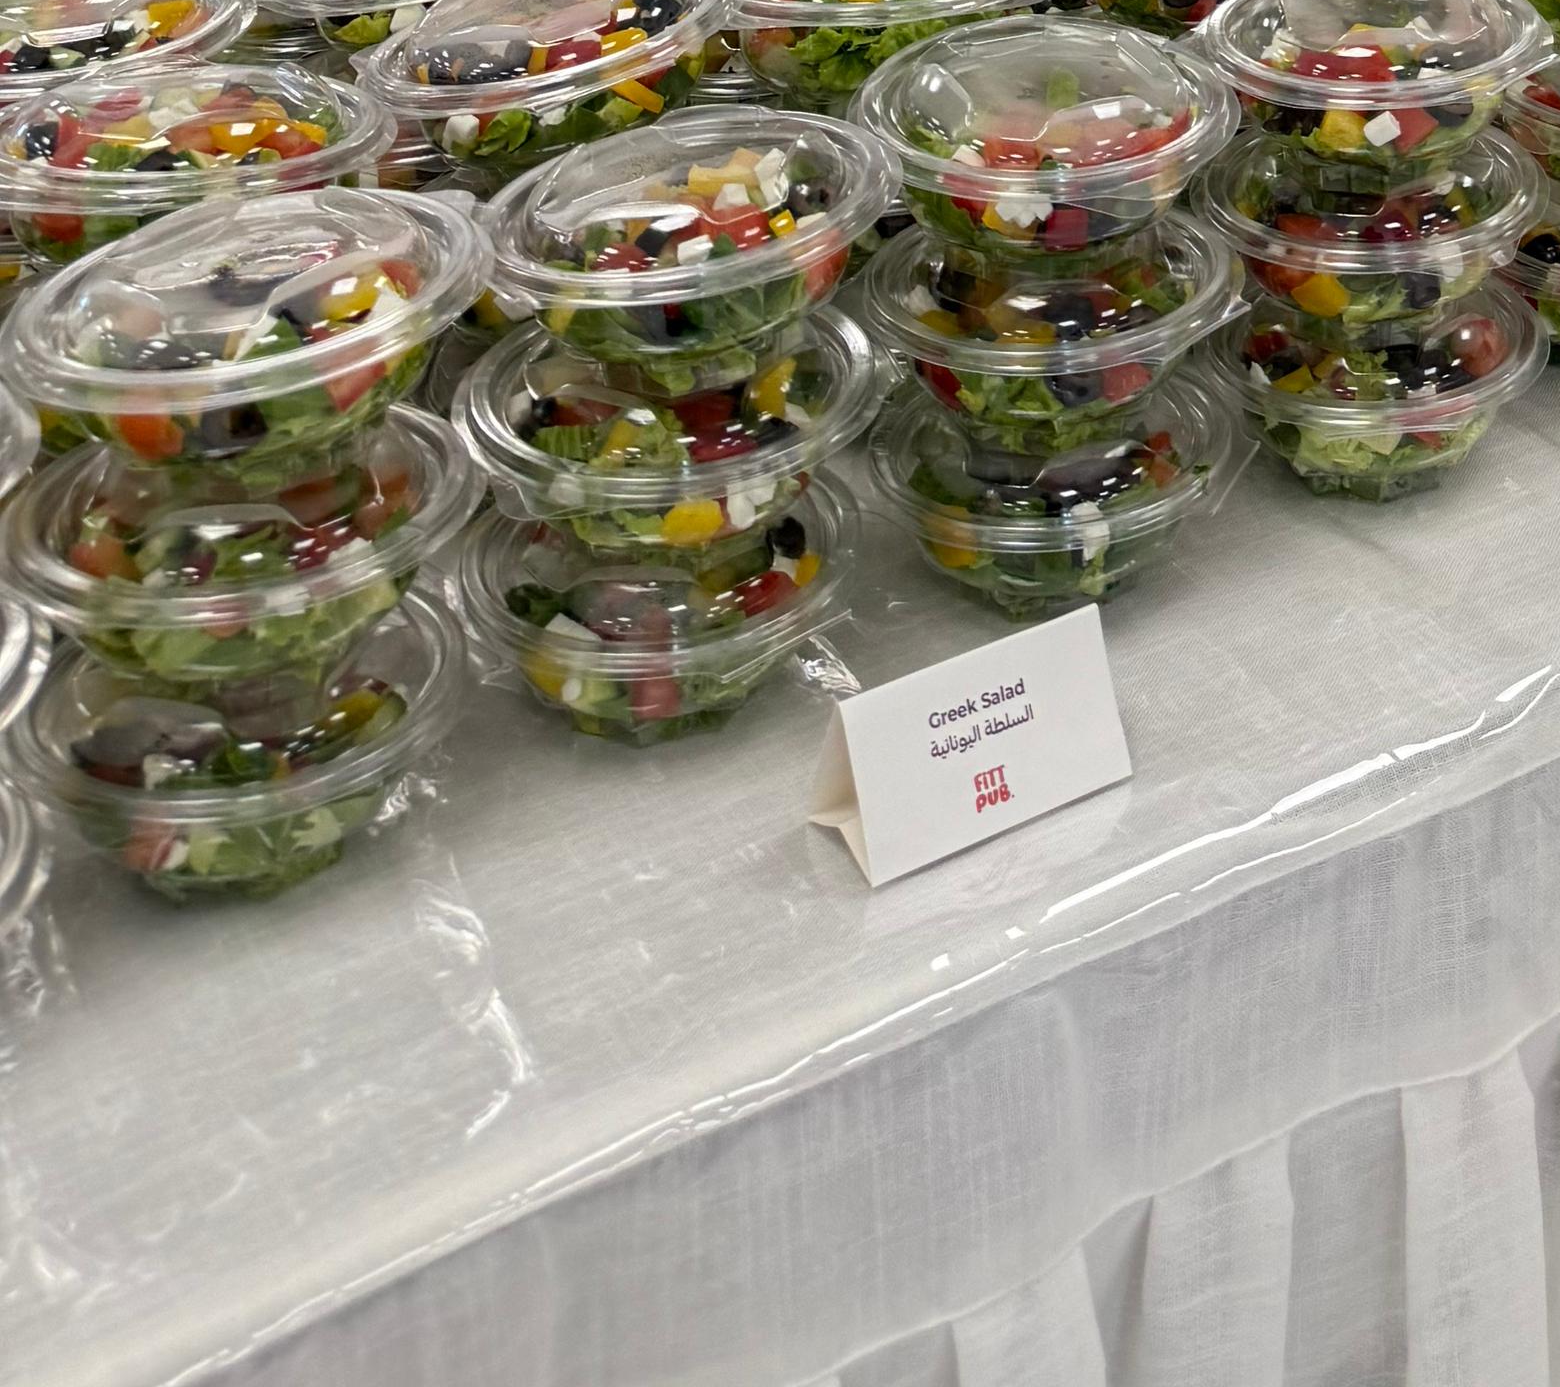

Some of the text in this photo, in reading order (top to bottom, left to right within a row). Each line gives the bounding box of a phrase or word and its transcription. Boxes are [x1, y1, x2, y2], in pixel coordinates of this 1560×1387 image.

[928, 678, 1026, 729] Greek Salad
[931, 703, 1034, 759] السلطة اليونانية
